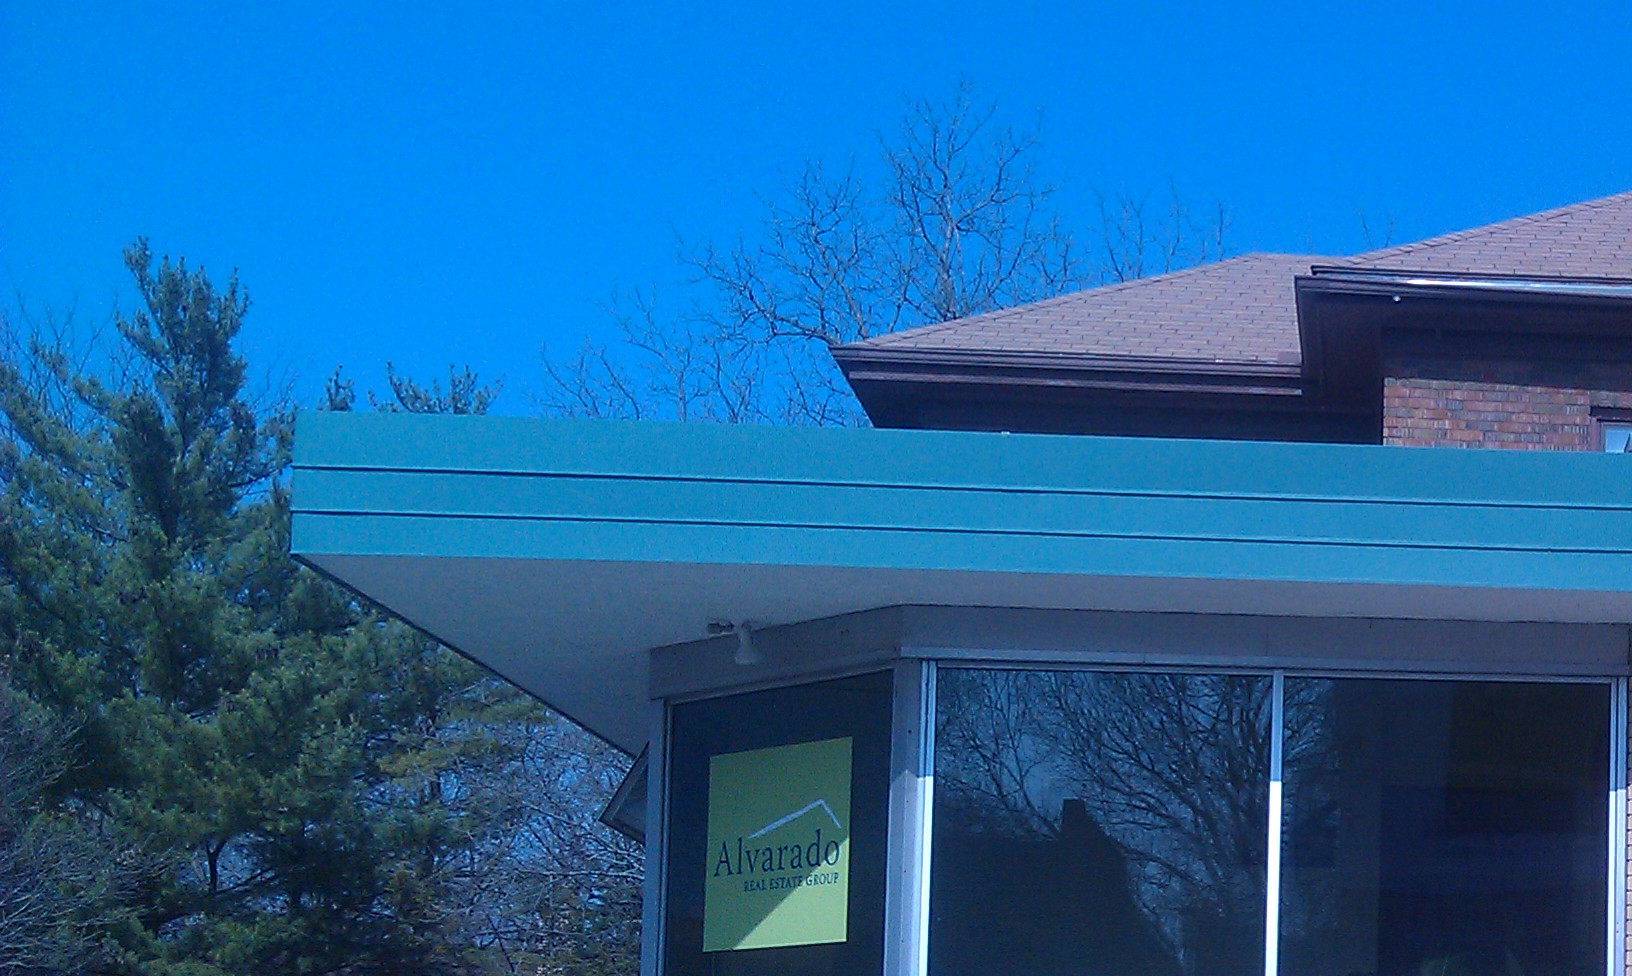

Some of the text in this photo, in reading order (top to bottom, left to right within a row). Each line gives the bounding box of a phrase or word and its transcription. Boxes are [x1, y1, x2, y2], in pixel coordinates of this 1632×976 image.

[714, 828, 840, 877] Alvarado
[744, 872, 839, 892] REAL ESTATE GROUP
